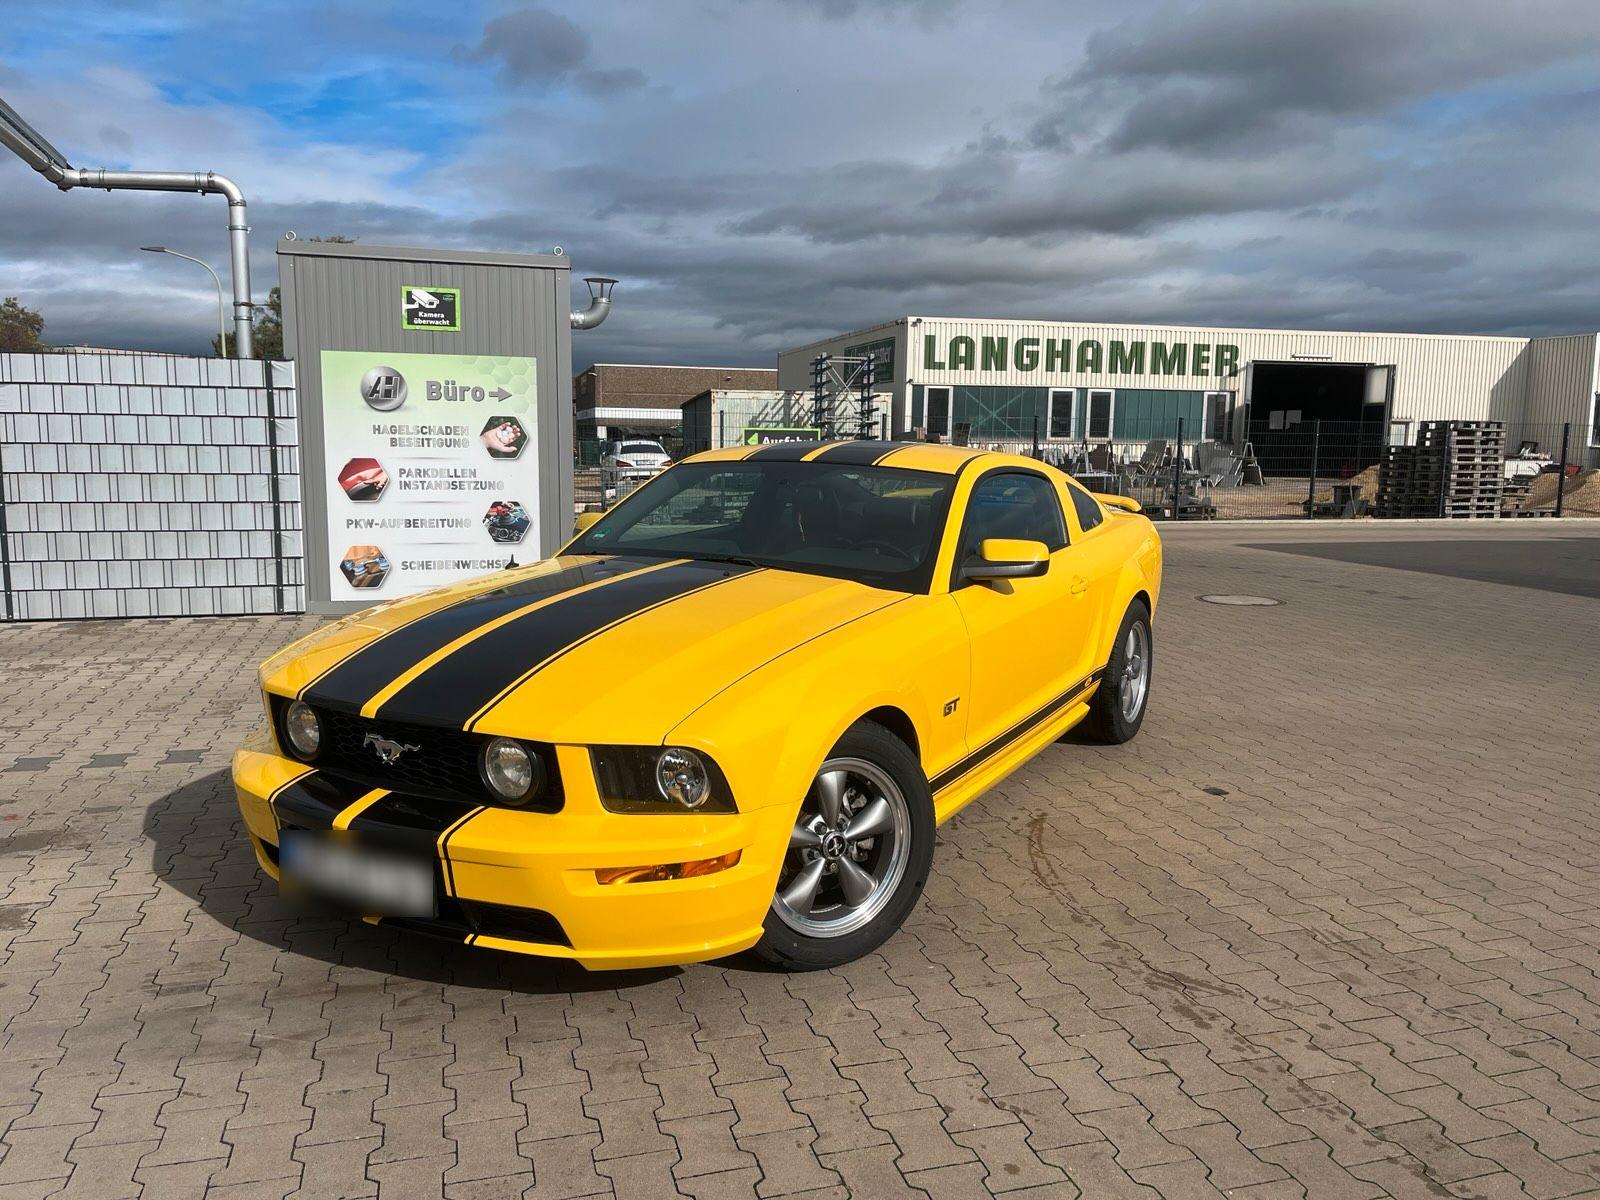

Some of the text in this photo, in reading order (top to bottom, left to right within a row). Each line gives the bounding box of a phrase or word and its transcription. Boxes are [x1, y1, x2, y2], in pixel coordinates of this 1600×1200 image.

[413, 317, 450, 326] überwacht
[924, 334, 1239, 377] LANGHAMMER
[426, 380, 485, 402] Büro
[372, 425, 470, 436] HAGELSCHADEN
[390, 437, 470, 448] BESEITIGUNG
[399, 468, 477, 479] PARKDELLEN
[399, 480, 505, 491] INSTANDSETZUNG
[346, 518, 472, 529] PKW-AUFBEREITUNG
[401, 559, 510, 570] SCHEIBENWECHSE
[943, 696, 960, 717] GT
